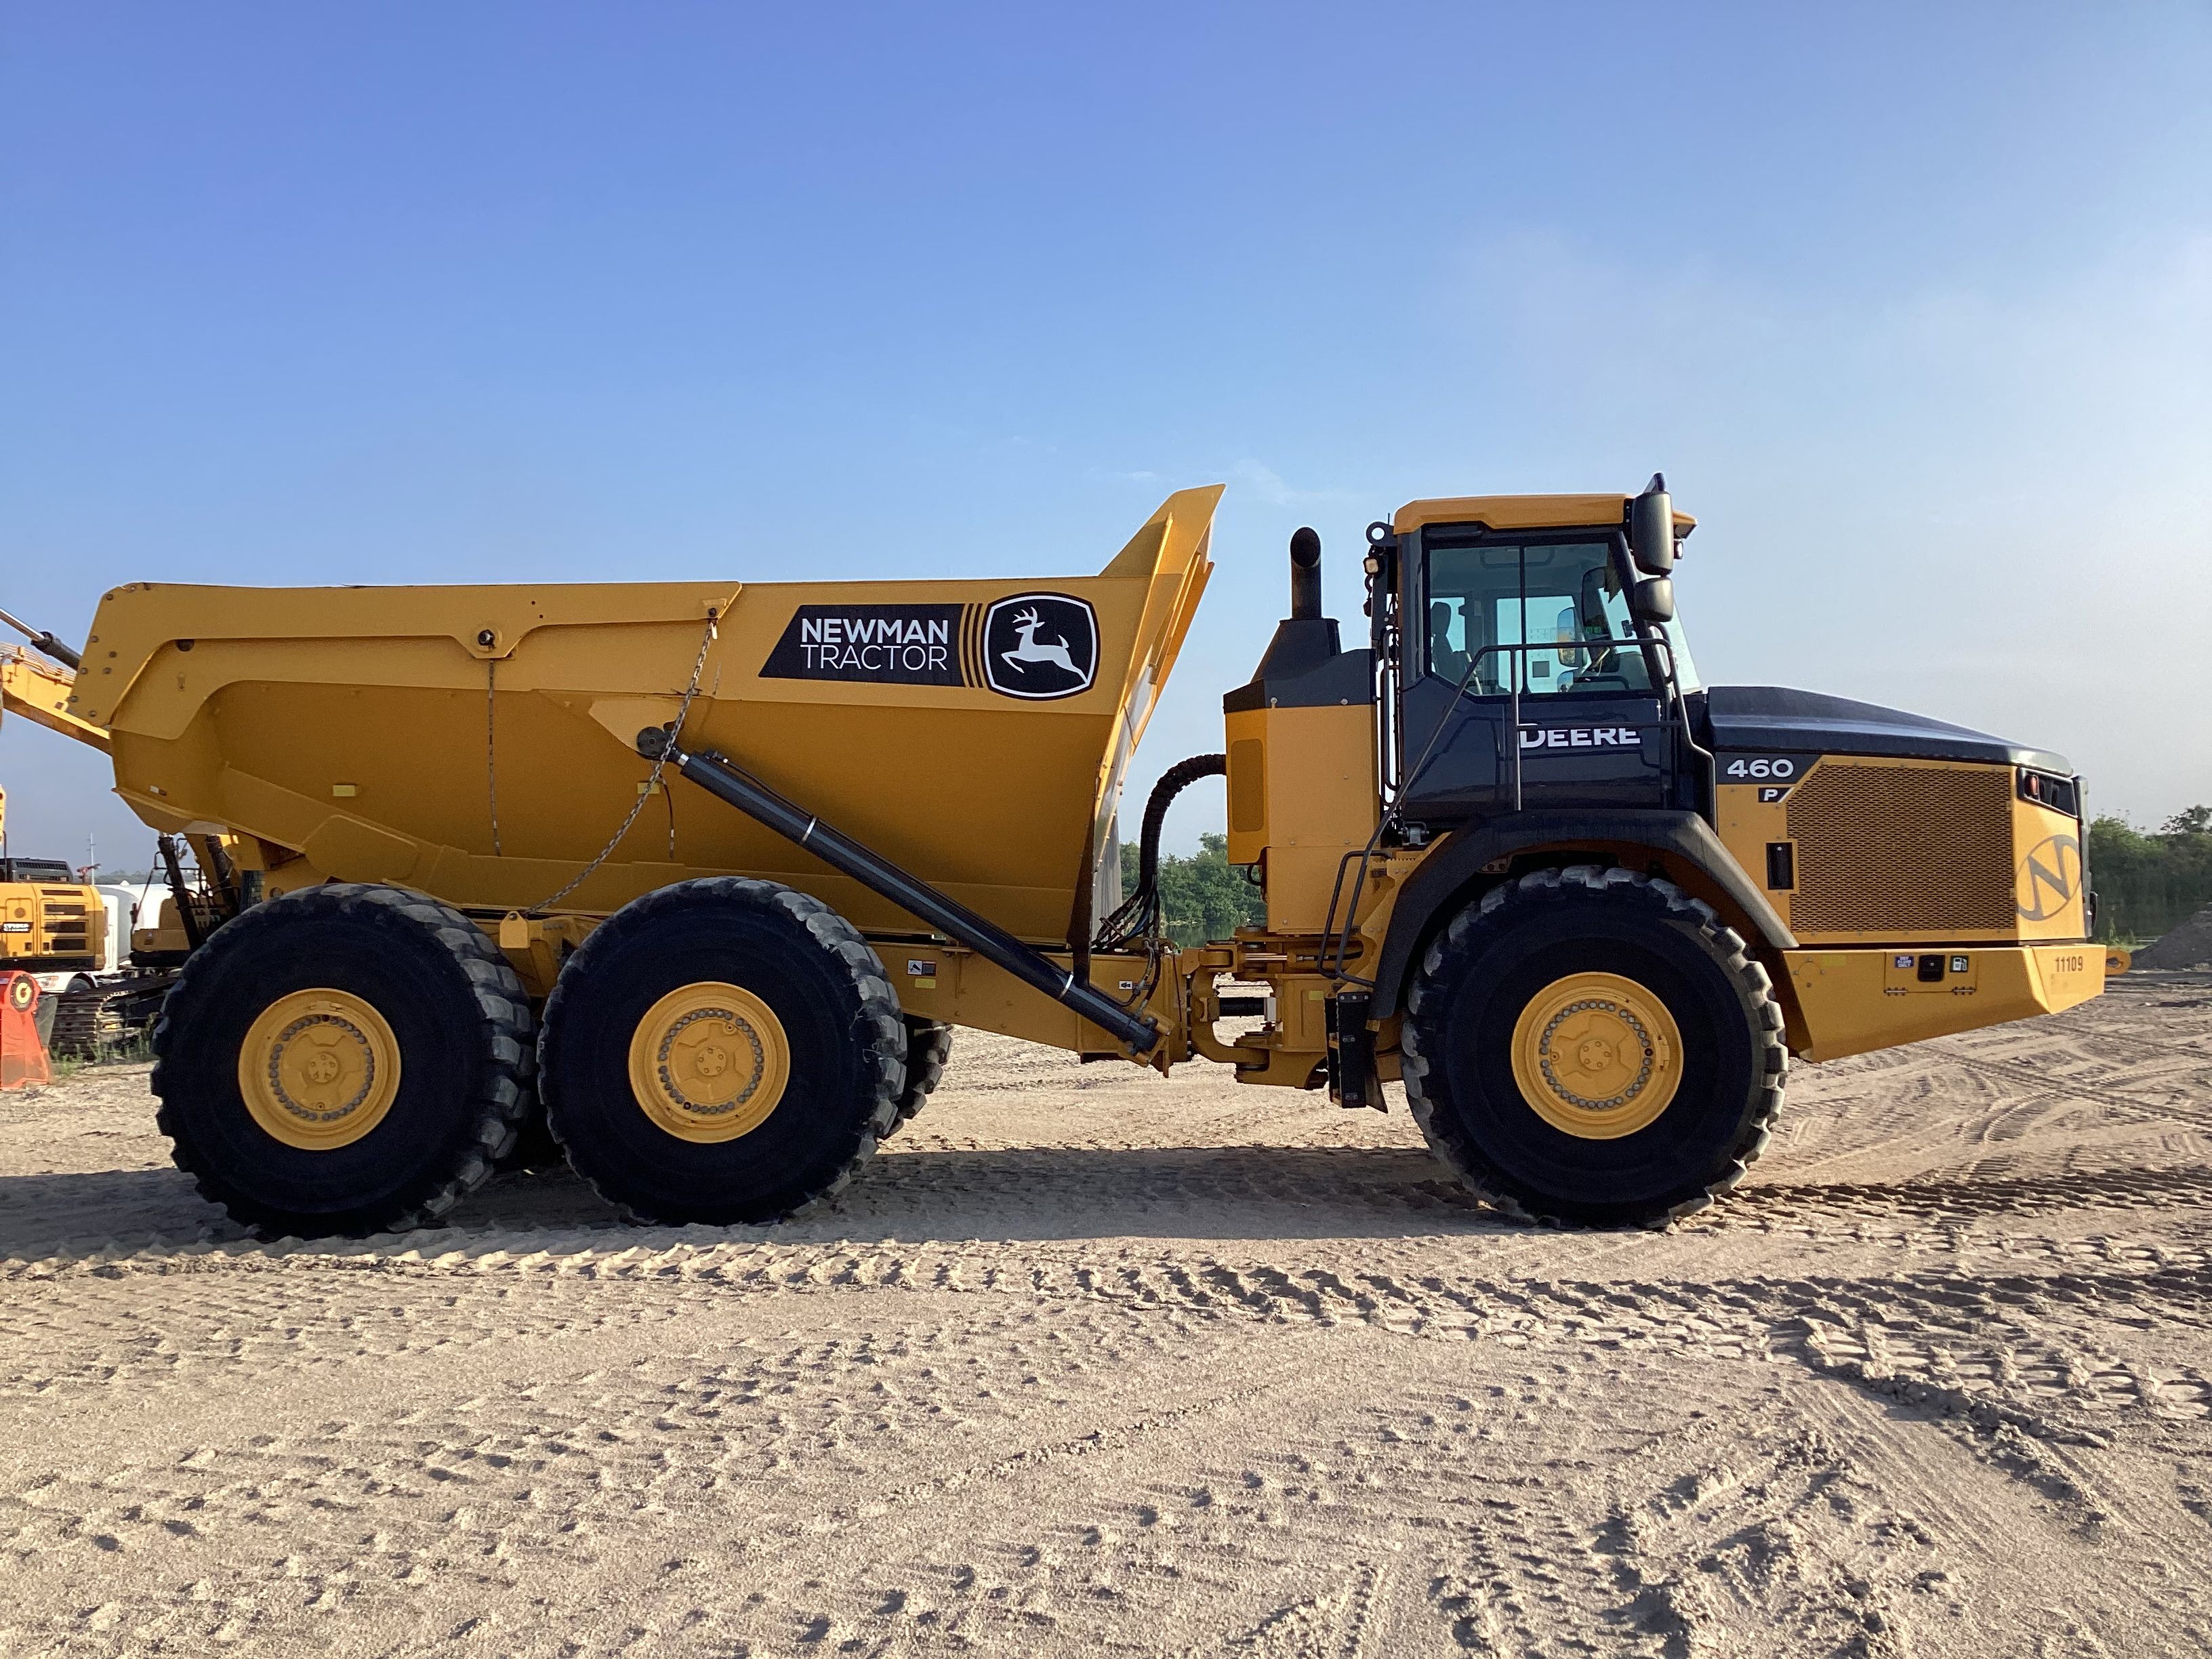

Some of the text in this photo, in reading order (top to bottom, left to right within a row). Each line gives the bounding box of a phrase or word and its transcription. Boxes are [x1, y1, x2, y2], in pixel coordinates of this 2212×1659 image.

[802, 618, 948, 644] NEWMAN
[800, 644, 947, 670] TRACTOR
[1519, 727, 1641, 749] DEERE
[1727, 758, 1795, 778] 460
[1763, 789, 1778, 801] P
[2055, 956, 2083, 972] 11109
